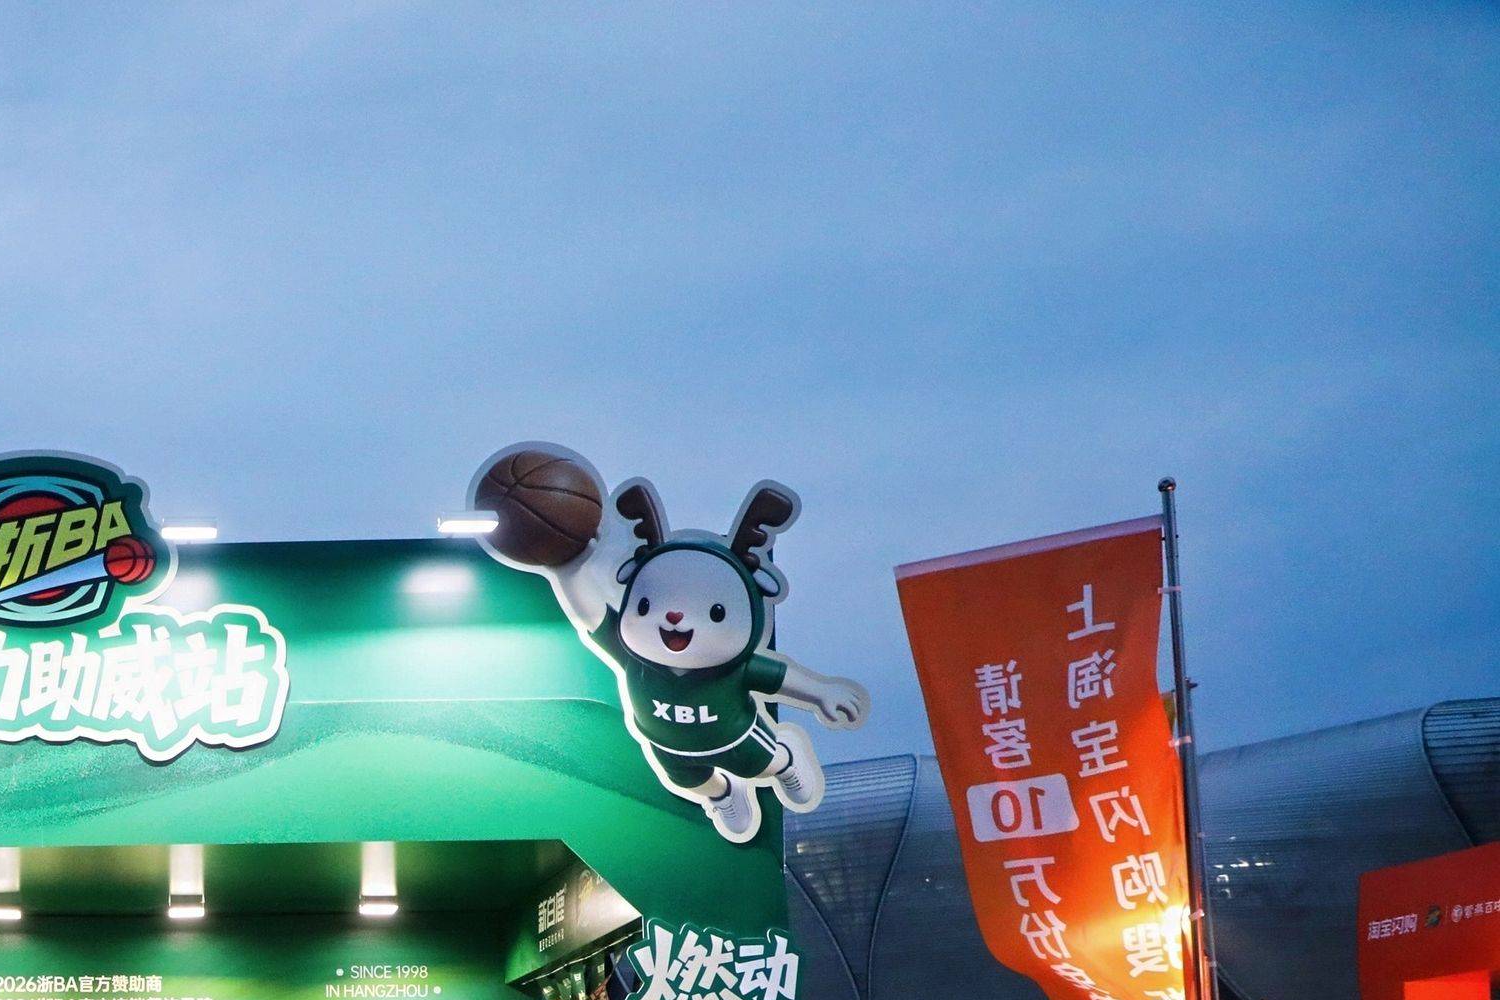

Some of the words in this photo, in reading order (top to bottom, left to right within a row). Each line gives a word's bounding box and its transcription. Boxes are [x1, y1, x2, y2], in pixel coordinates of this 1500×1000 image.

[652, 699, 718, 724] XBL
[350, 965, 392, 979] SINCE
[396, 965, 428, 979] 1998
[326, 985, 339, 998] IN
[344, 985, 428, 998] HANGZHOU
